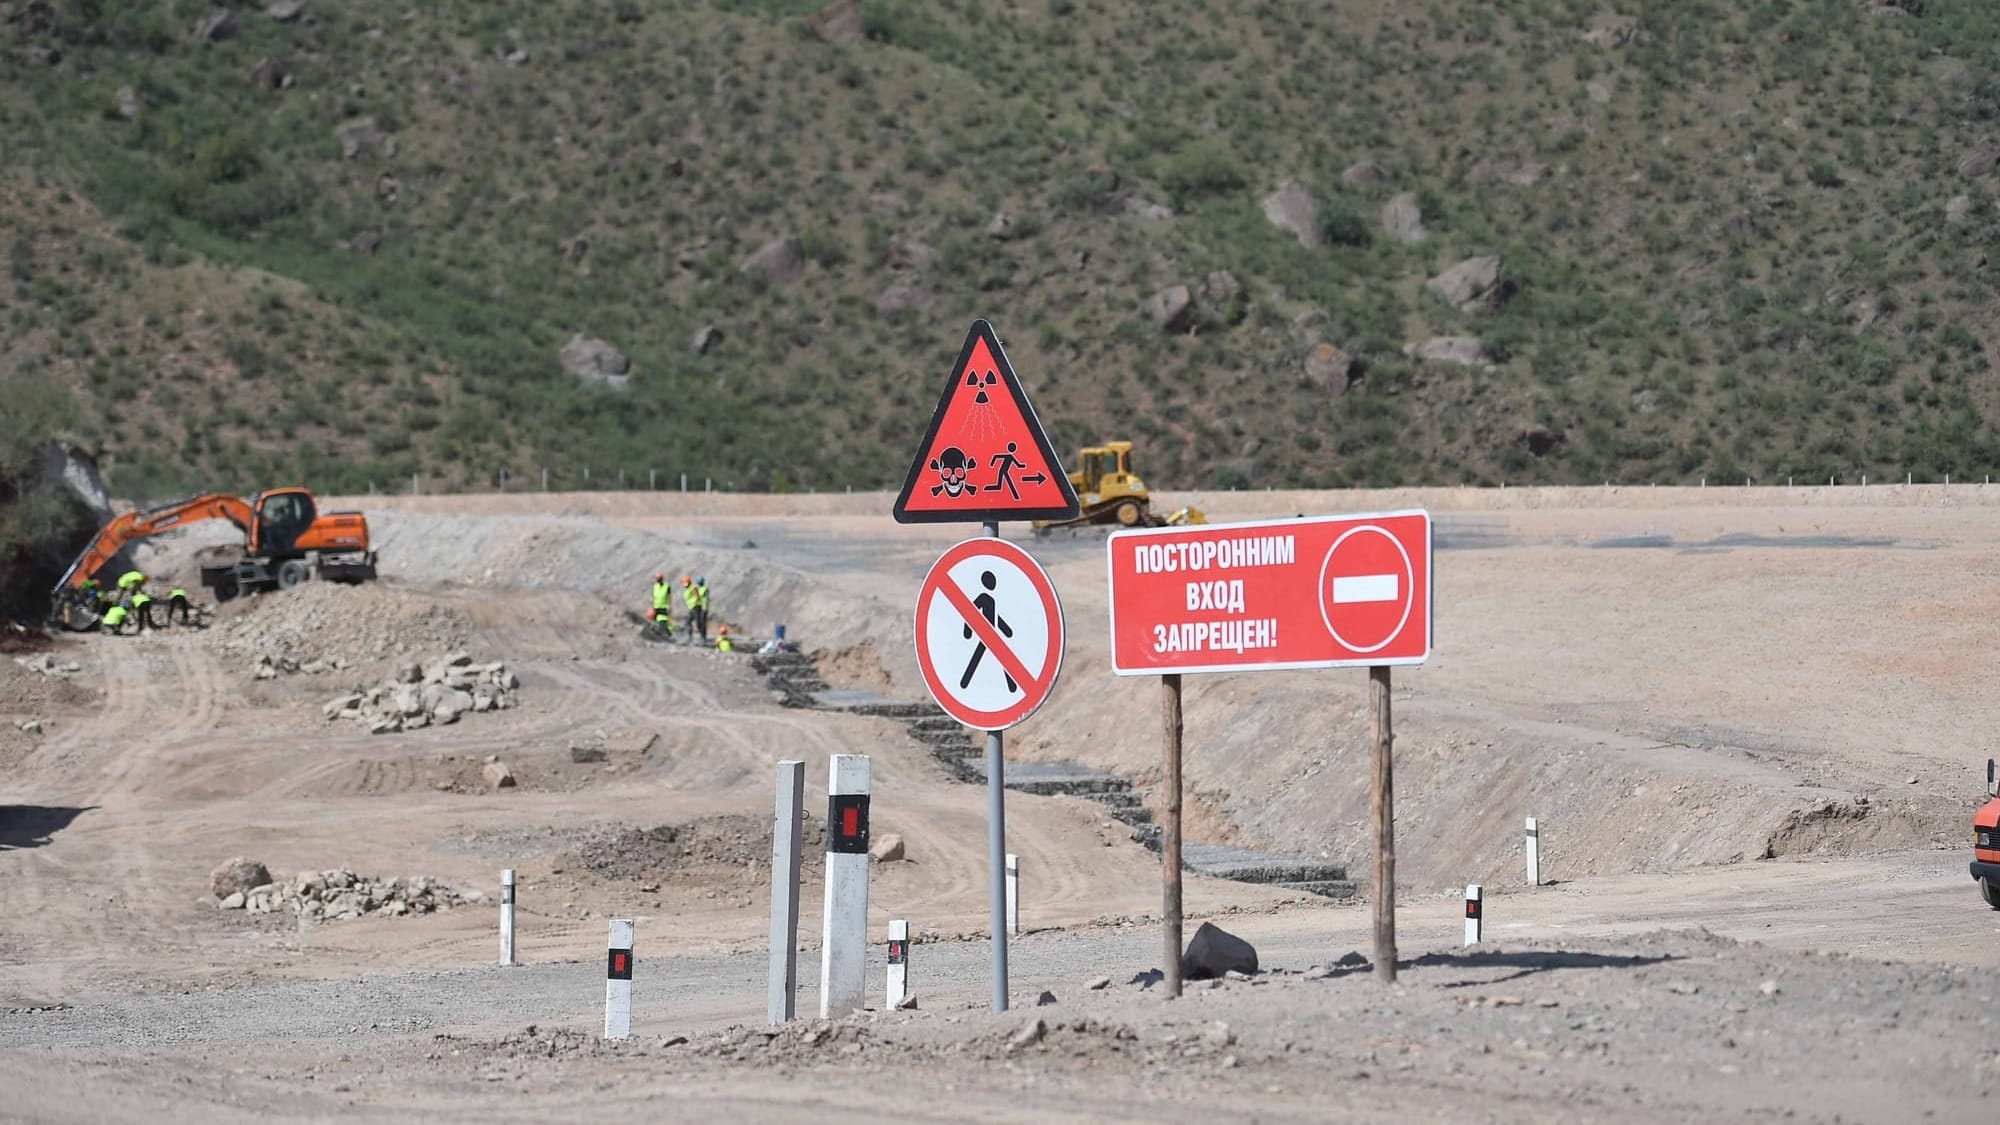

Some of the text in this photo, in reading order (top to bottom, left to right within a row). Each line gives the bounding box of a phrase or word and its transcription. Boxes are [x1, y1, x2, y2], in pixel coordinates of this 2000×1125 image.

[1135, 535, 1295, 574] ПОСТОРОННИМ
[1186, 579, 1245, 614] ВХОД
[1153, 618, 1277, 655] ЗАПРЕЩЕН!
